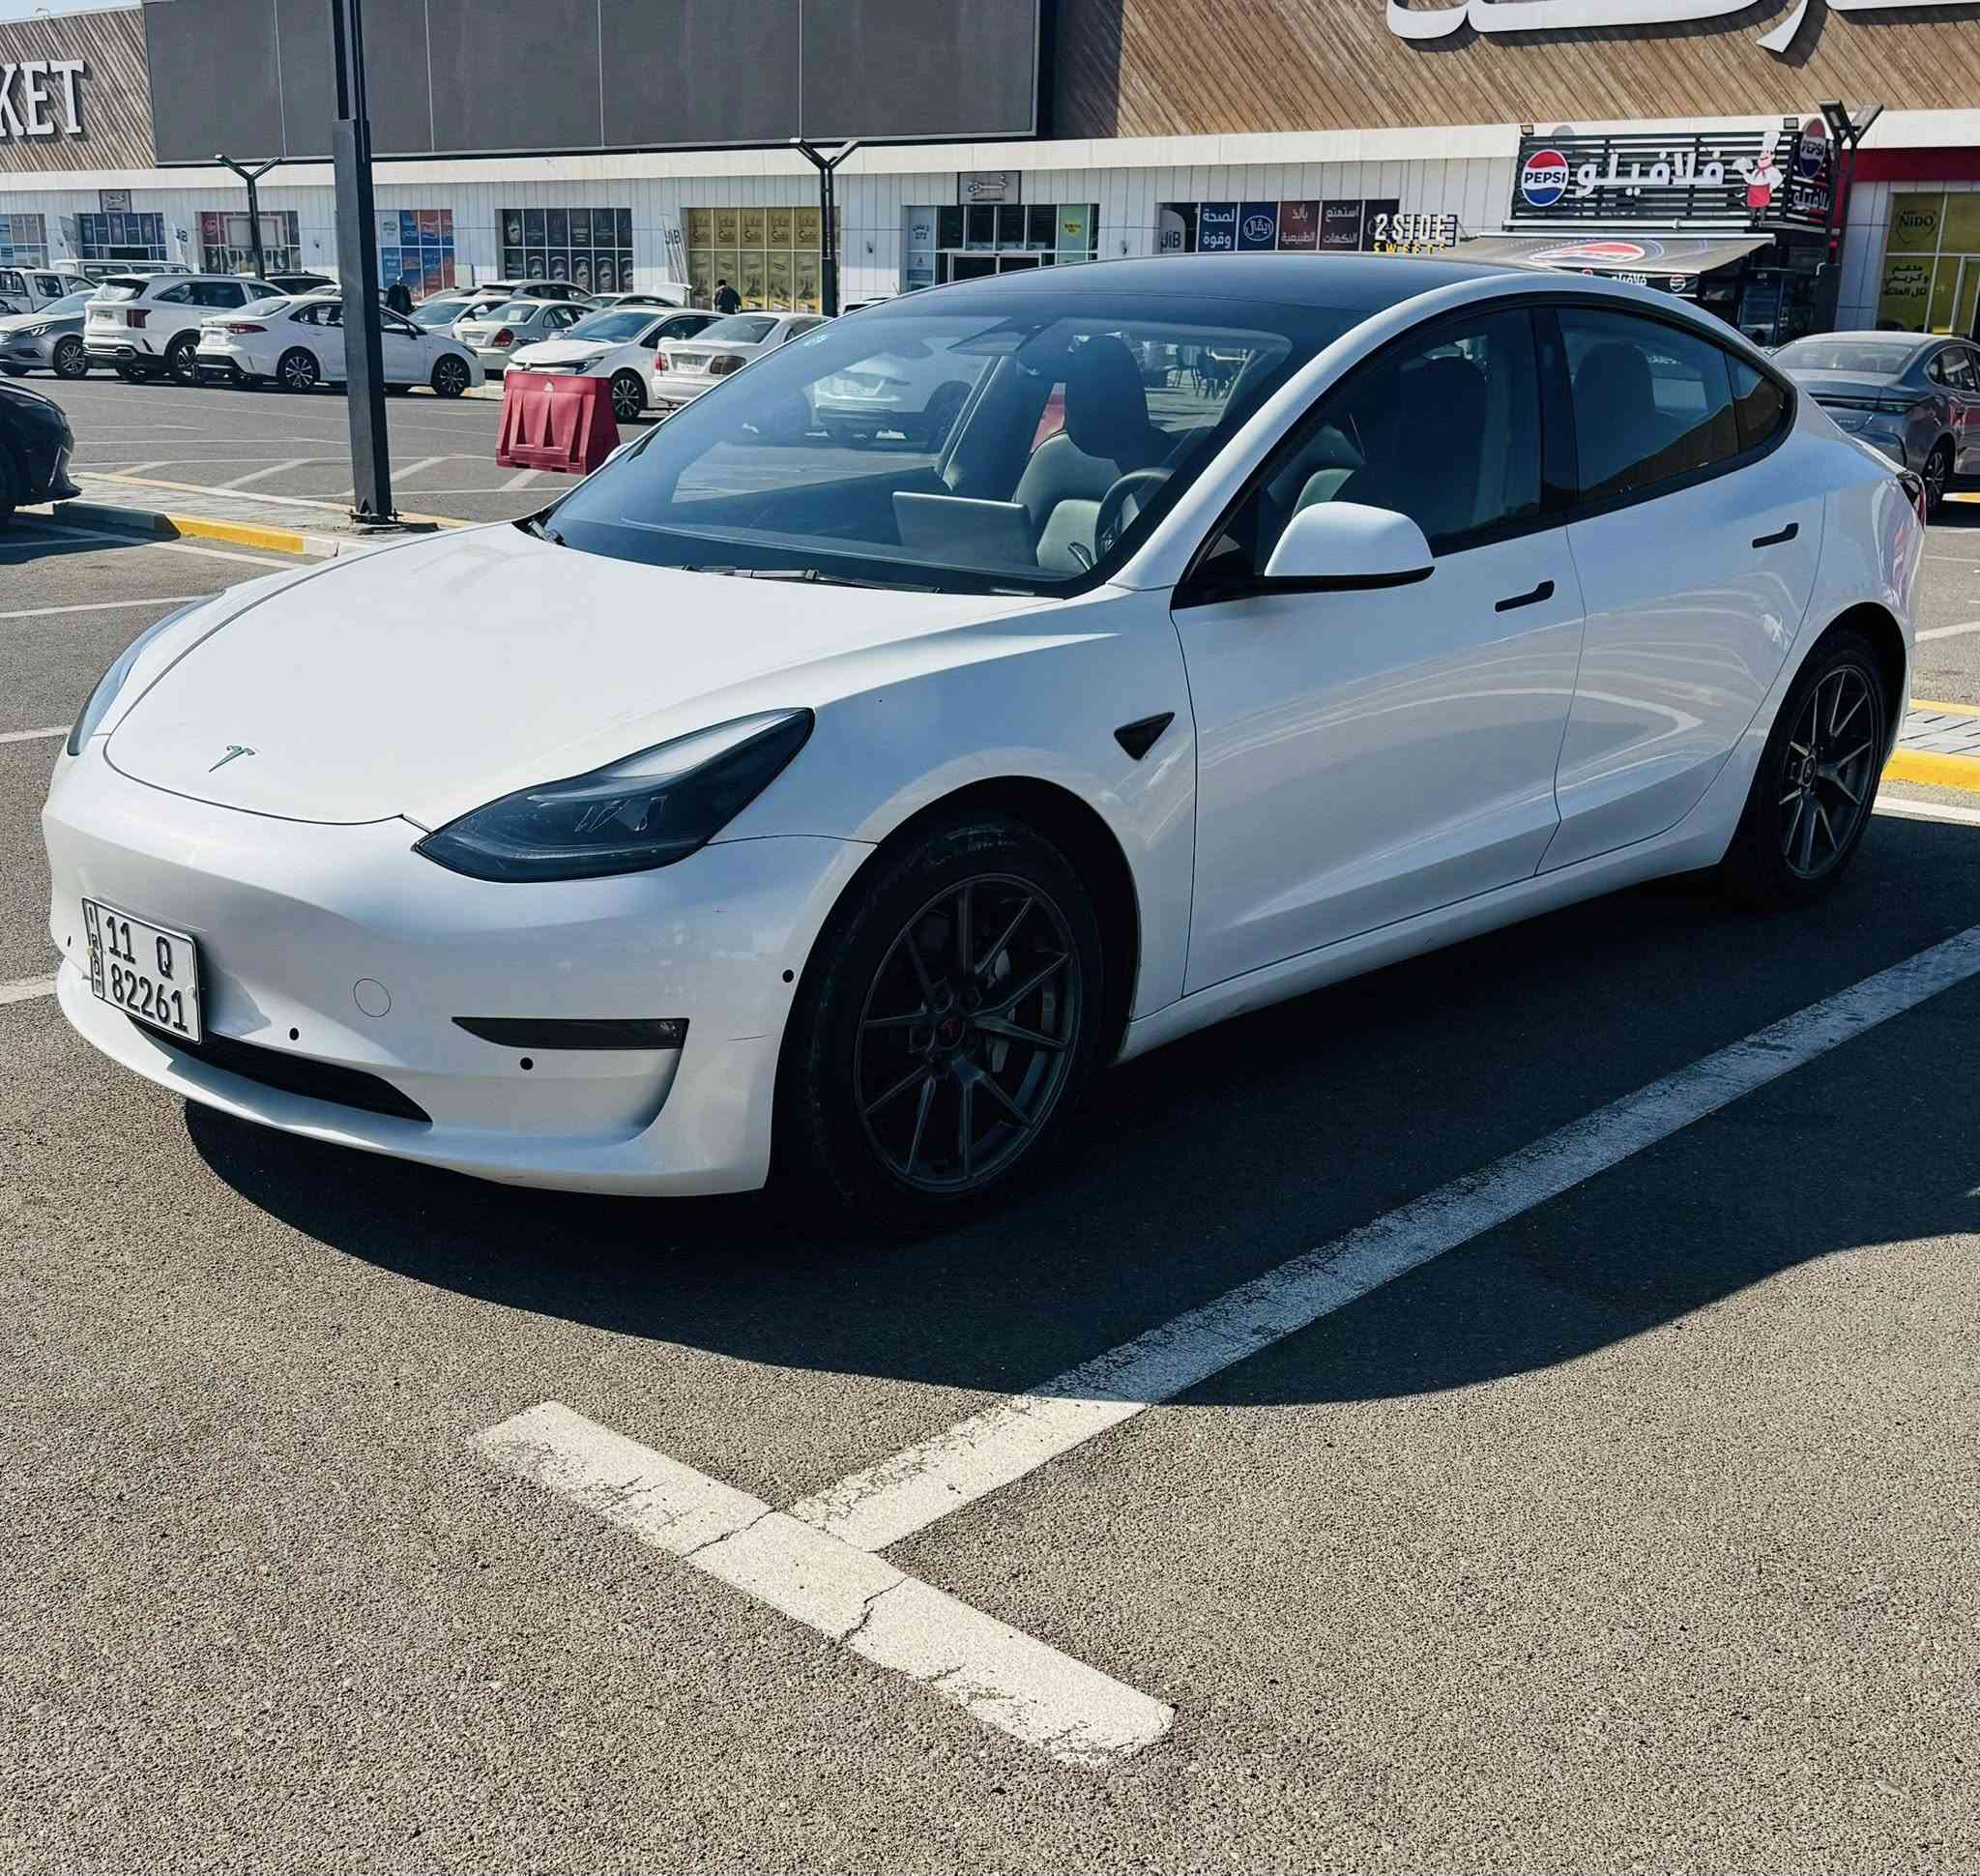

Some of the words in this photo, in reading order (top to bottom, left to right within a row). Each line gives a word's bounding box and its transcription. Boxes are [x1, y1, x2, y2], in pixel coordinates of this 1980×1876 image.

[1801, 139, 1825, 158] PEPSI
[1524, 171, 1565, 185] PEPSI
[1575, 150, 1725, 198] فلافيلو
[1203, 207, 1236, 223] لصحة
[1325, 204, 1359, 222] استمتع
[1900, 215, 1935, 227] NIDO
[1202, 231, 1233, 249] وقوة
[106, 915, 136, 964] 11
[156, 936, 174, 981] Q
[110, 963, 189, 1032] 82261
